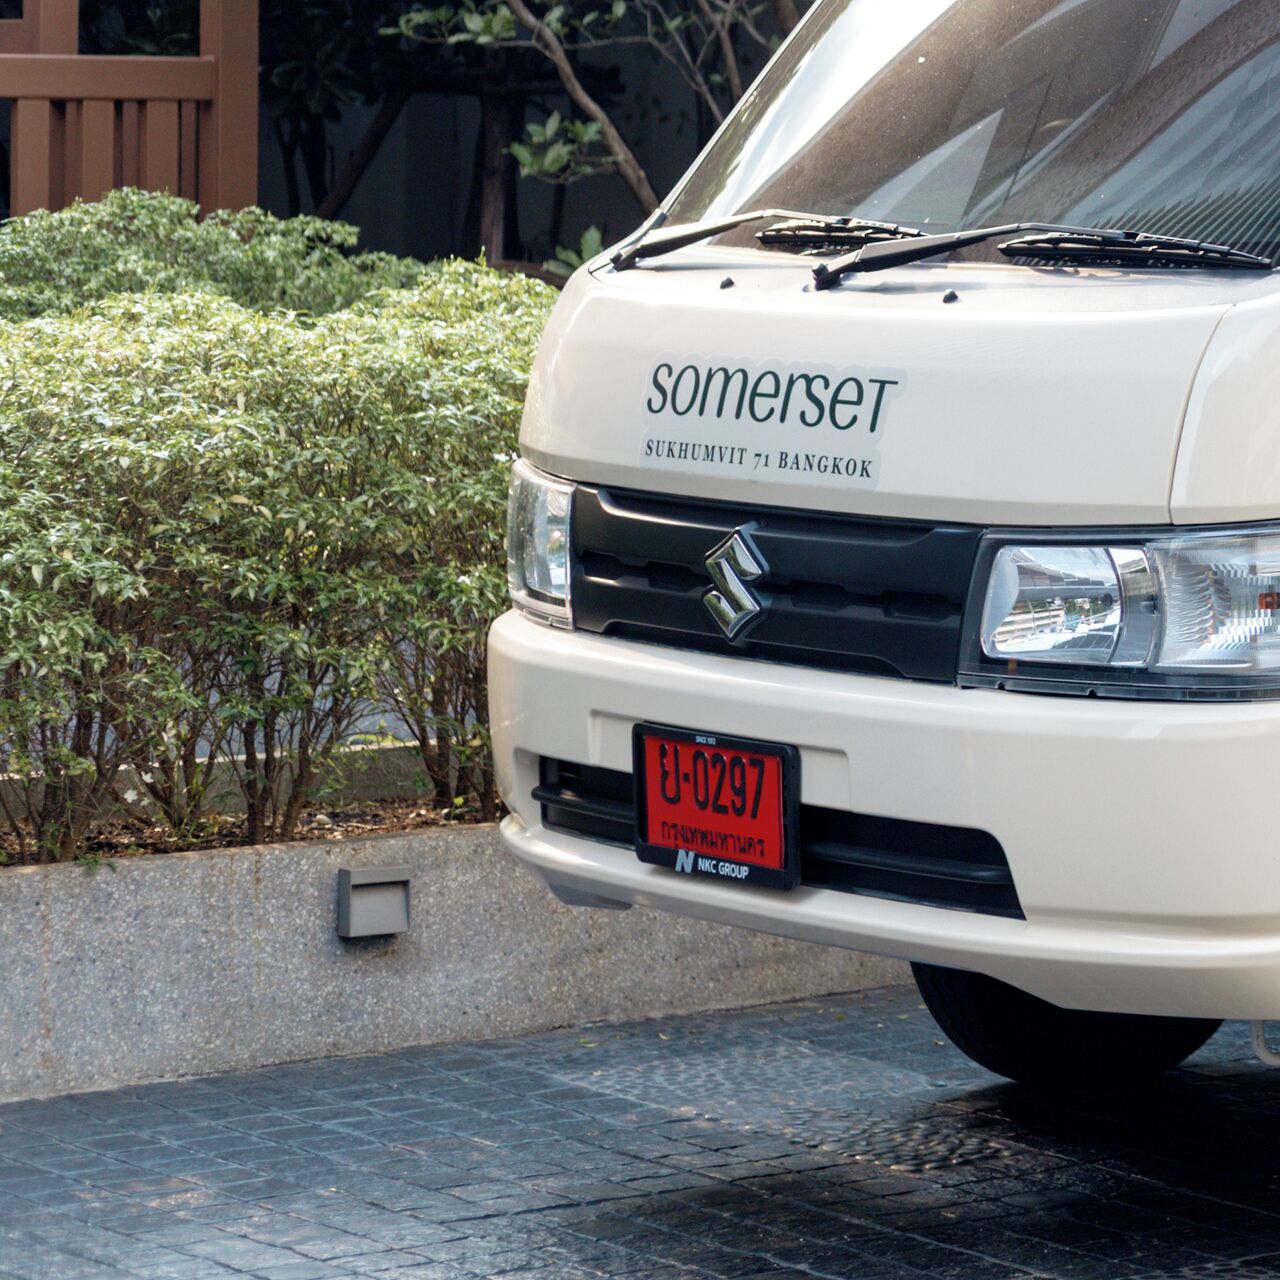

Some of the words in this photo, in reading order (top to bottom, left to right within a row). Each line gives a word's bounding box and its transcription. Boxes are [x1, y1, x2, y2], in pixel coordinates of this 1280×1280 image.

[645, 439, 748, 465] SUKHUMVIT
[754, 453, 769, 470] 71
[778, 451, 873, 479] BANGKOK
[697, 857, 717, 874] NKC
[718, 862, 749, 880] GROUP
